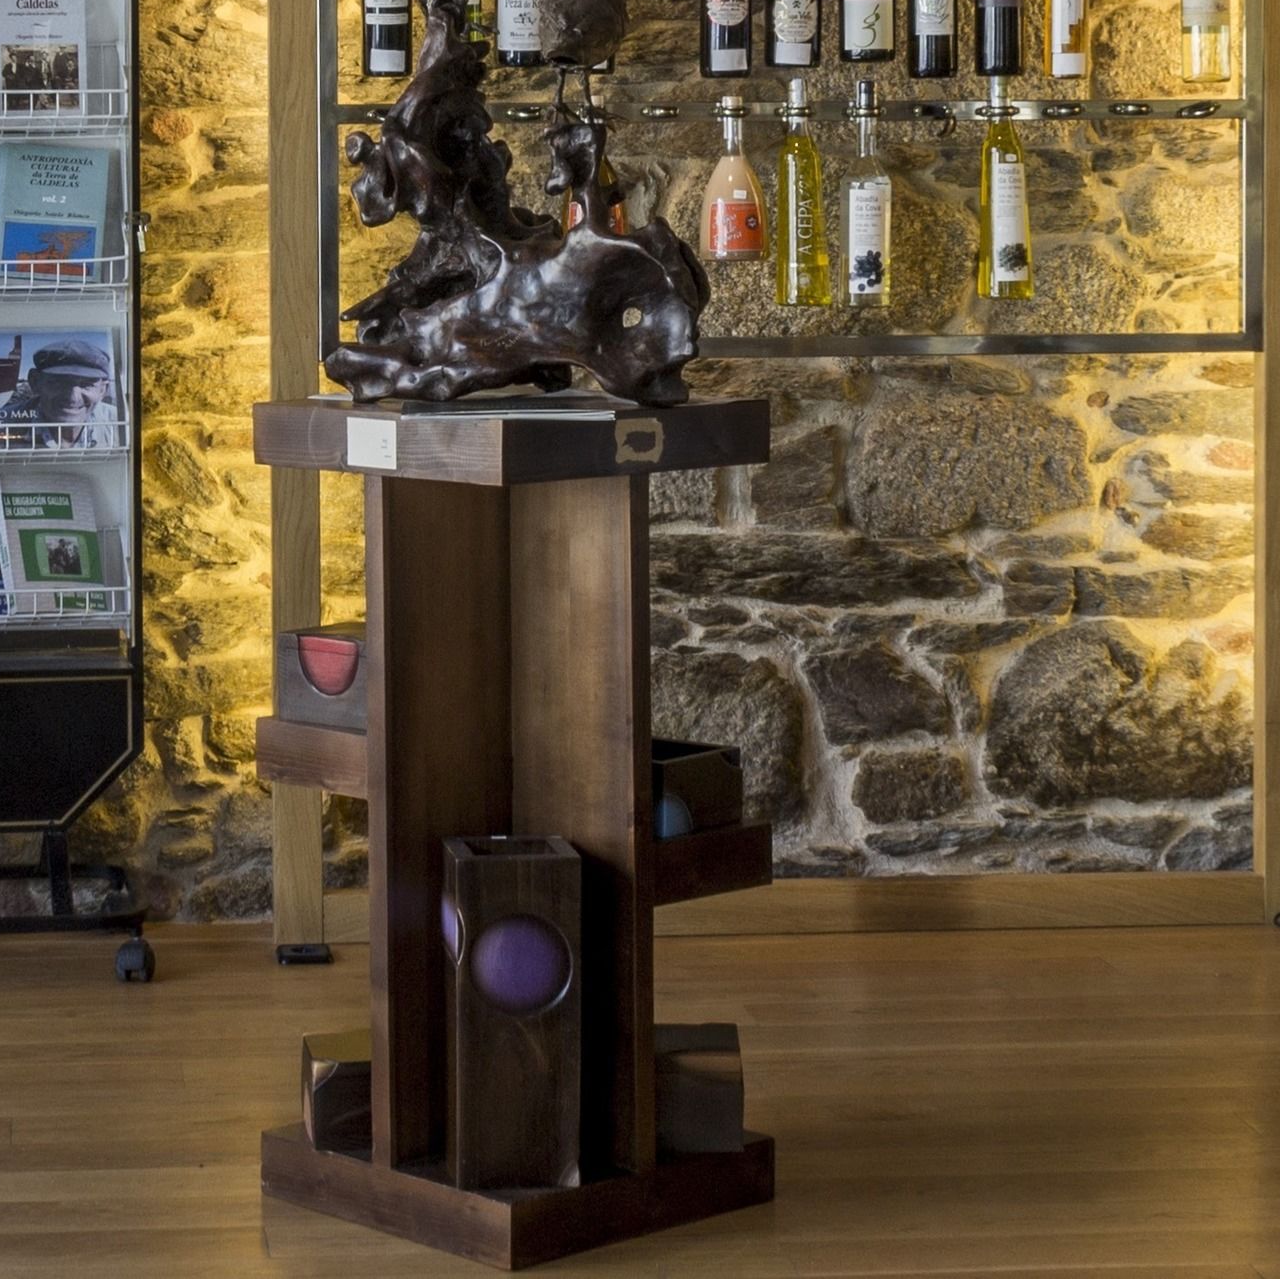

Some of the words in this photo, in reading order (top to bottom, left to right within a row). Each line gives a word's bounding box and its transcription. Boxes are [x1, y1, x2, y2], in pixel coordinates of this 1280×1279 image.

[19, 154, 94, 166] ANTROPOLOXÍA
[30, 163, 81, 173] CULTURAL
[45, 172, 66, 180] Terra
[30, 179, 80, 188] CALDELAS
[798, 198, 813, 239] CEPA
[798, 245, 812, 255] A
[11, 410, 38, 418] MAR
